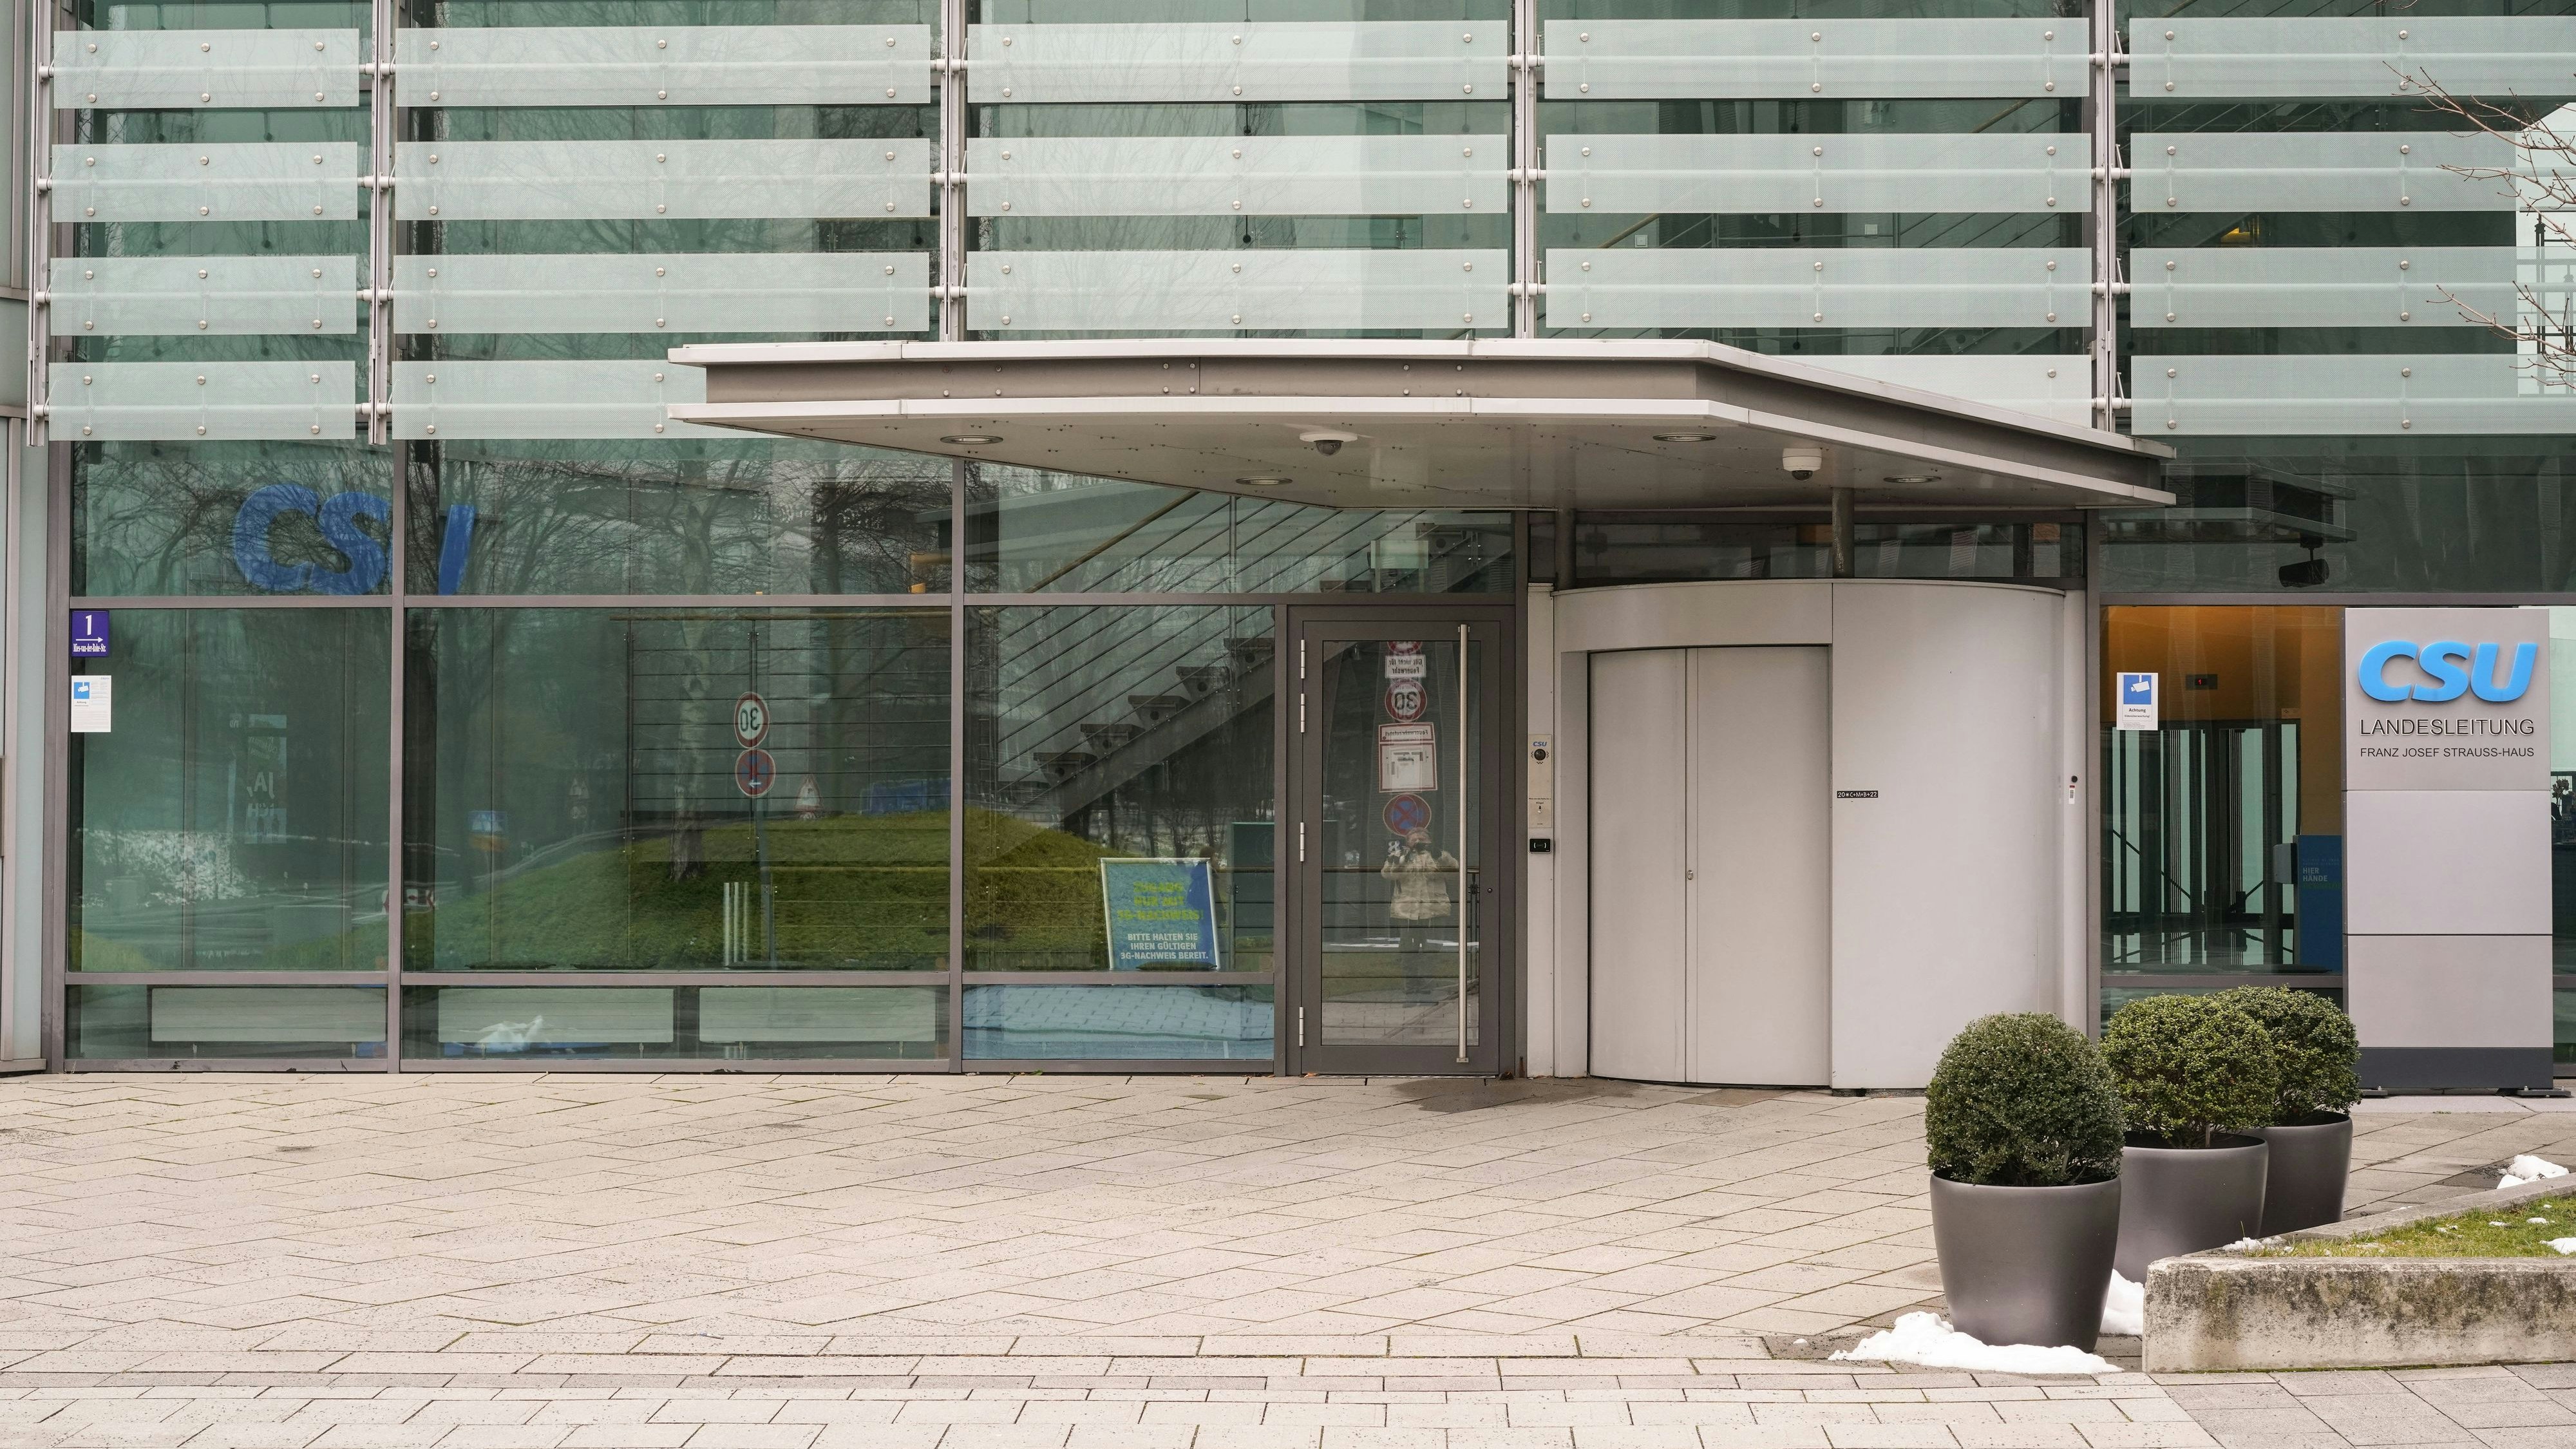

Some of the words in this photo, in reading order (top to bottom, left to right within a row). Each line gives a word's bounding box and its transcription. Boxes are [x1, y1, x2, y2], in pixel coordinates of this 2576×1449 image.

[85, 614, 92, 636] 1
[2358, 640, 2539, 703] CSU
[2360, 719, 2535, 735] LANDESLEITUNG
[2360, 748, 2399, 757] FRANZ
[2402, 748, 2439, 757] JOSEF
[2443, 747, 2534, 757] STRAUSS-HAUS
[1153, 933, 1184, 941] HALTEN
[1157, 941, 1197, 950] GÜLTIGEN
[1179, 951, 1209, 960] BEREIT.
